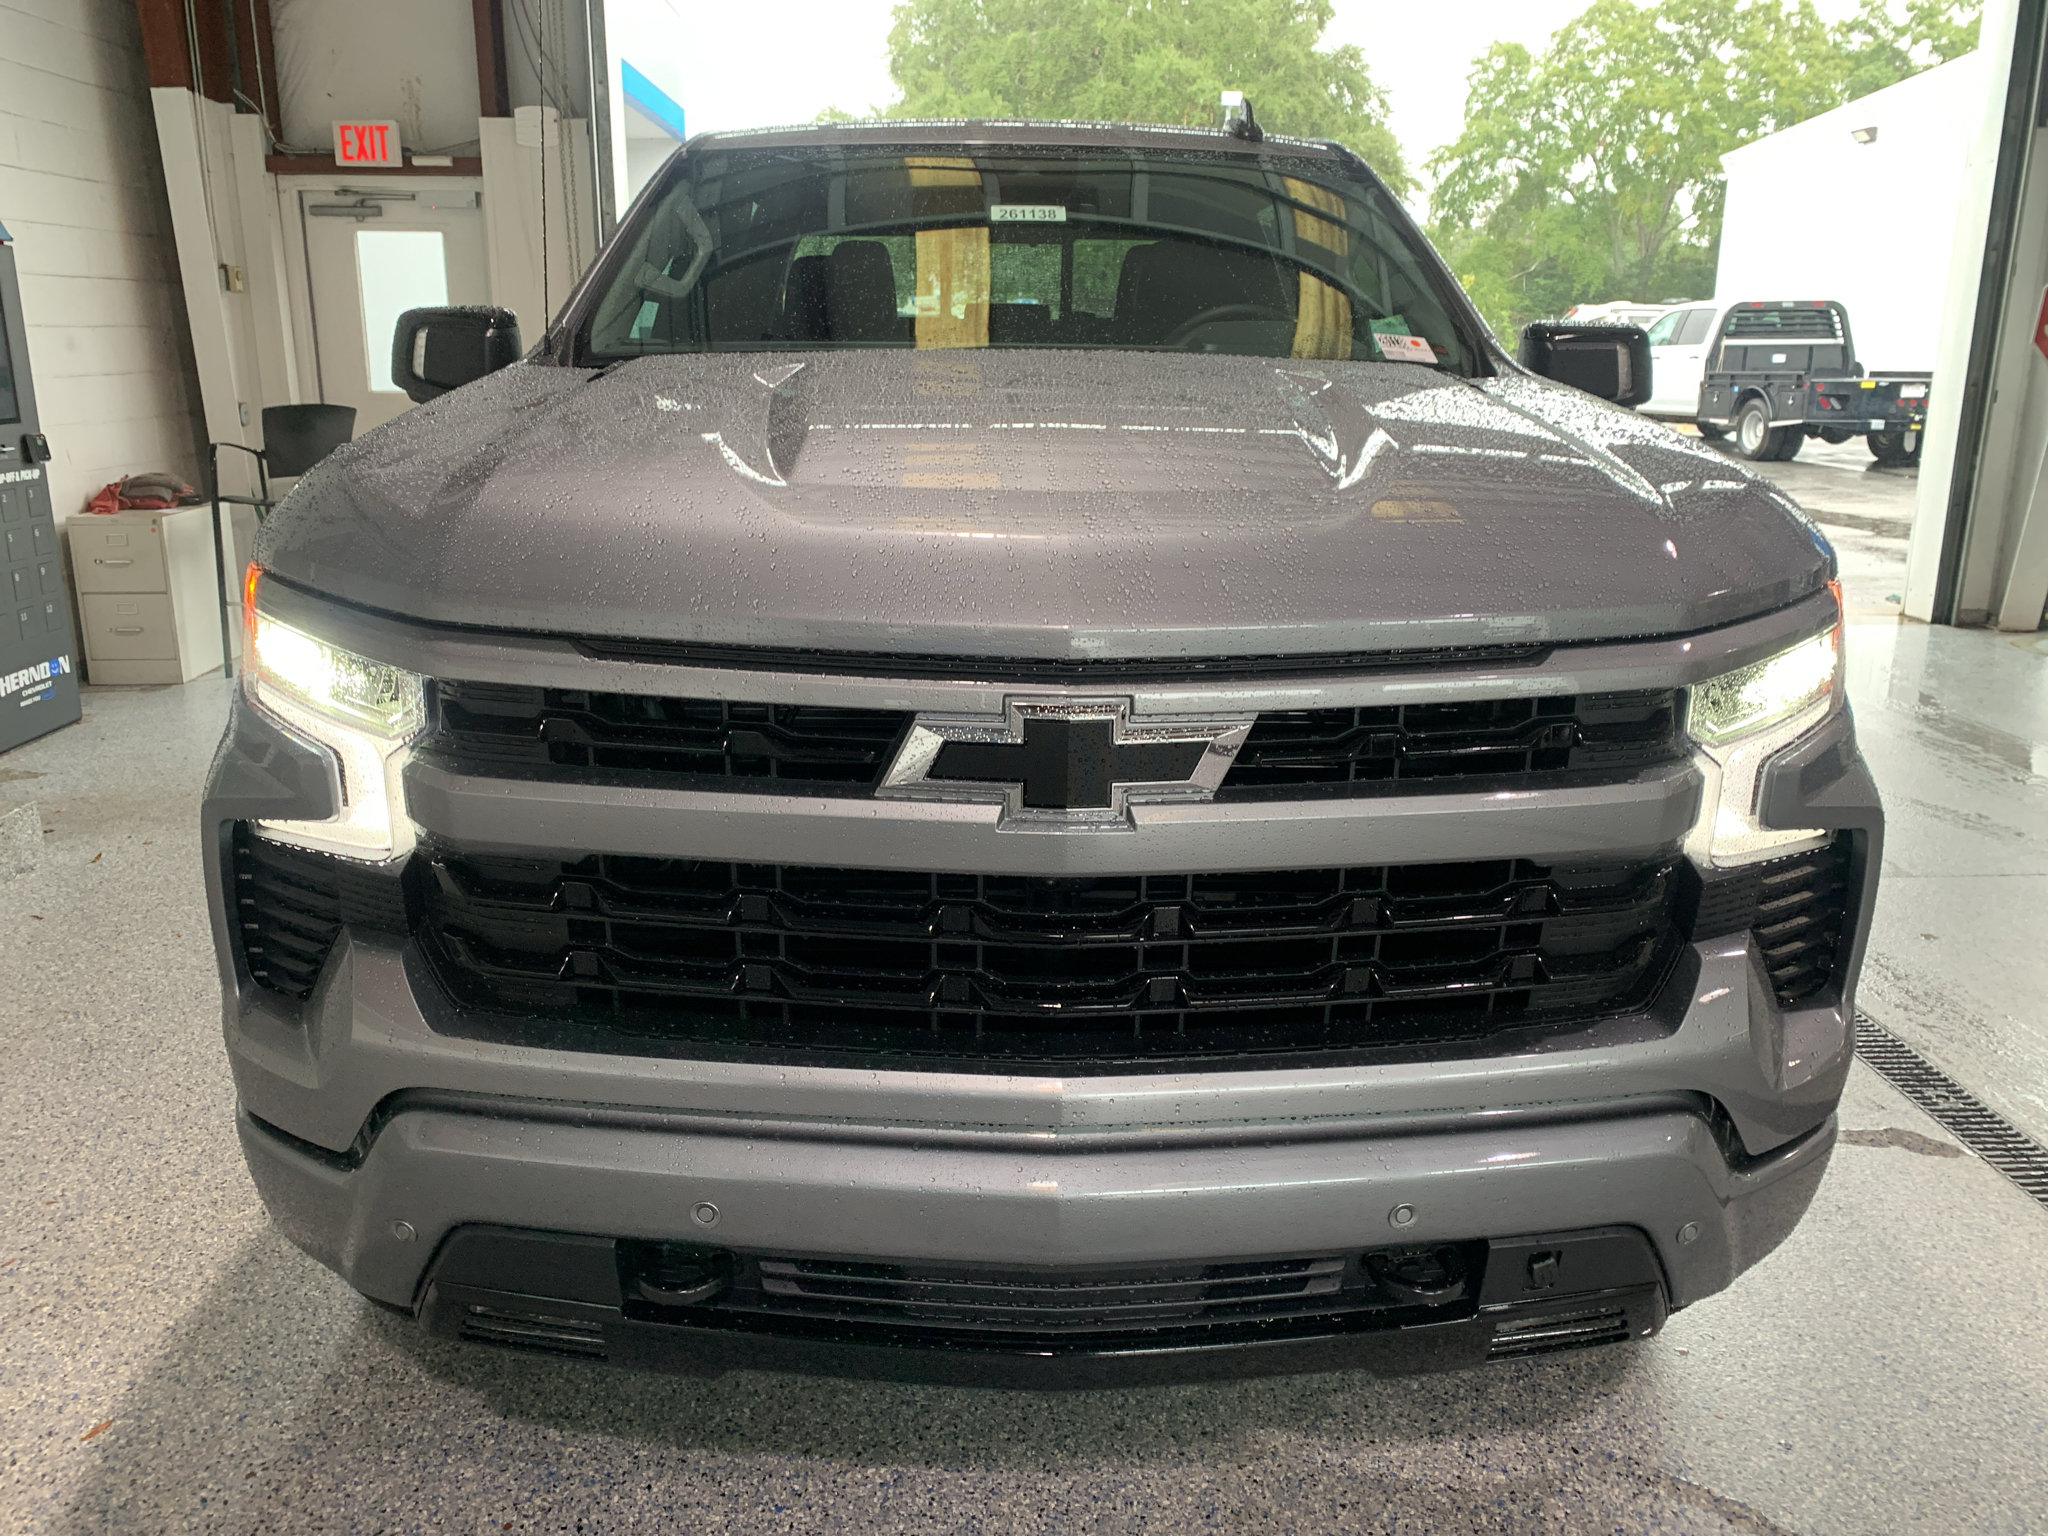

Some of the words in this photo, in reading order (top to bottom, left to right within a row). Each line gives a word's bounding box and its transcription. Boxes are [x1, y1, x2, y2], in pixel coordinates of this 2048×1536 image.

[339, 125, 389, 161] EXIT
[1000, 209, 1056, 219] 261138
[20, 468, 40, 480] PICK-UP
[2, 494, 7, 503] 2
[34, 528, 39, 537] 6
[7, 534, 13, 542] 5
[40, 567, 45, 575] 9
[46, 604, 53, 613] 12
[20, 612, 27, 621] 11
[0, 654, 71, 698] HERNDON
